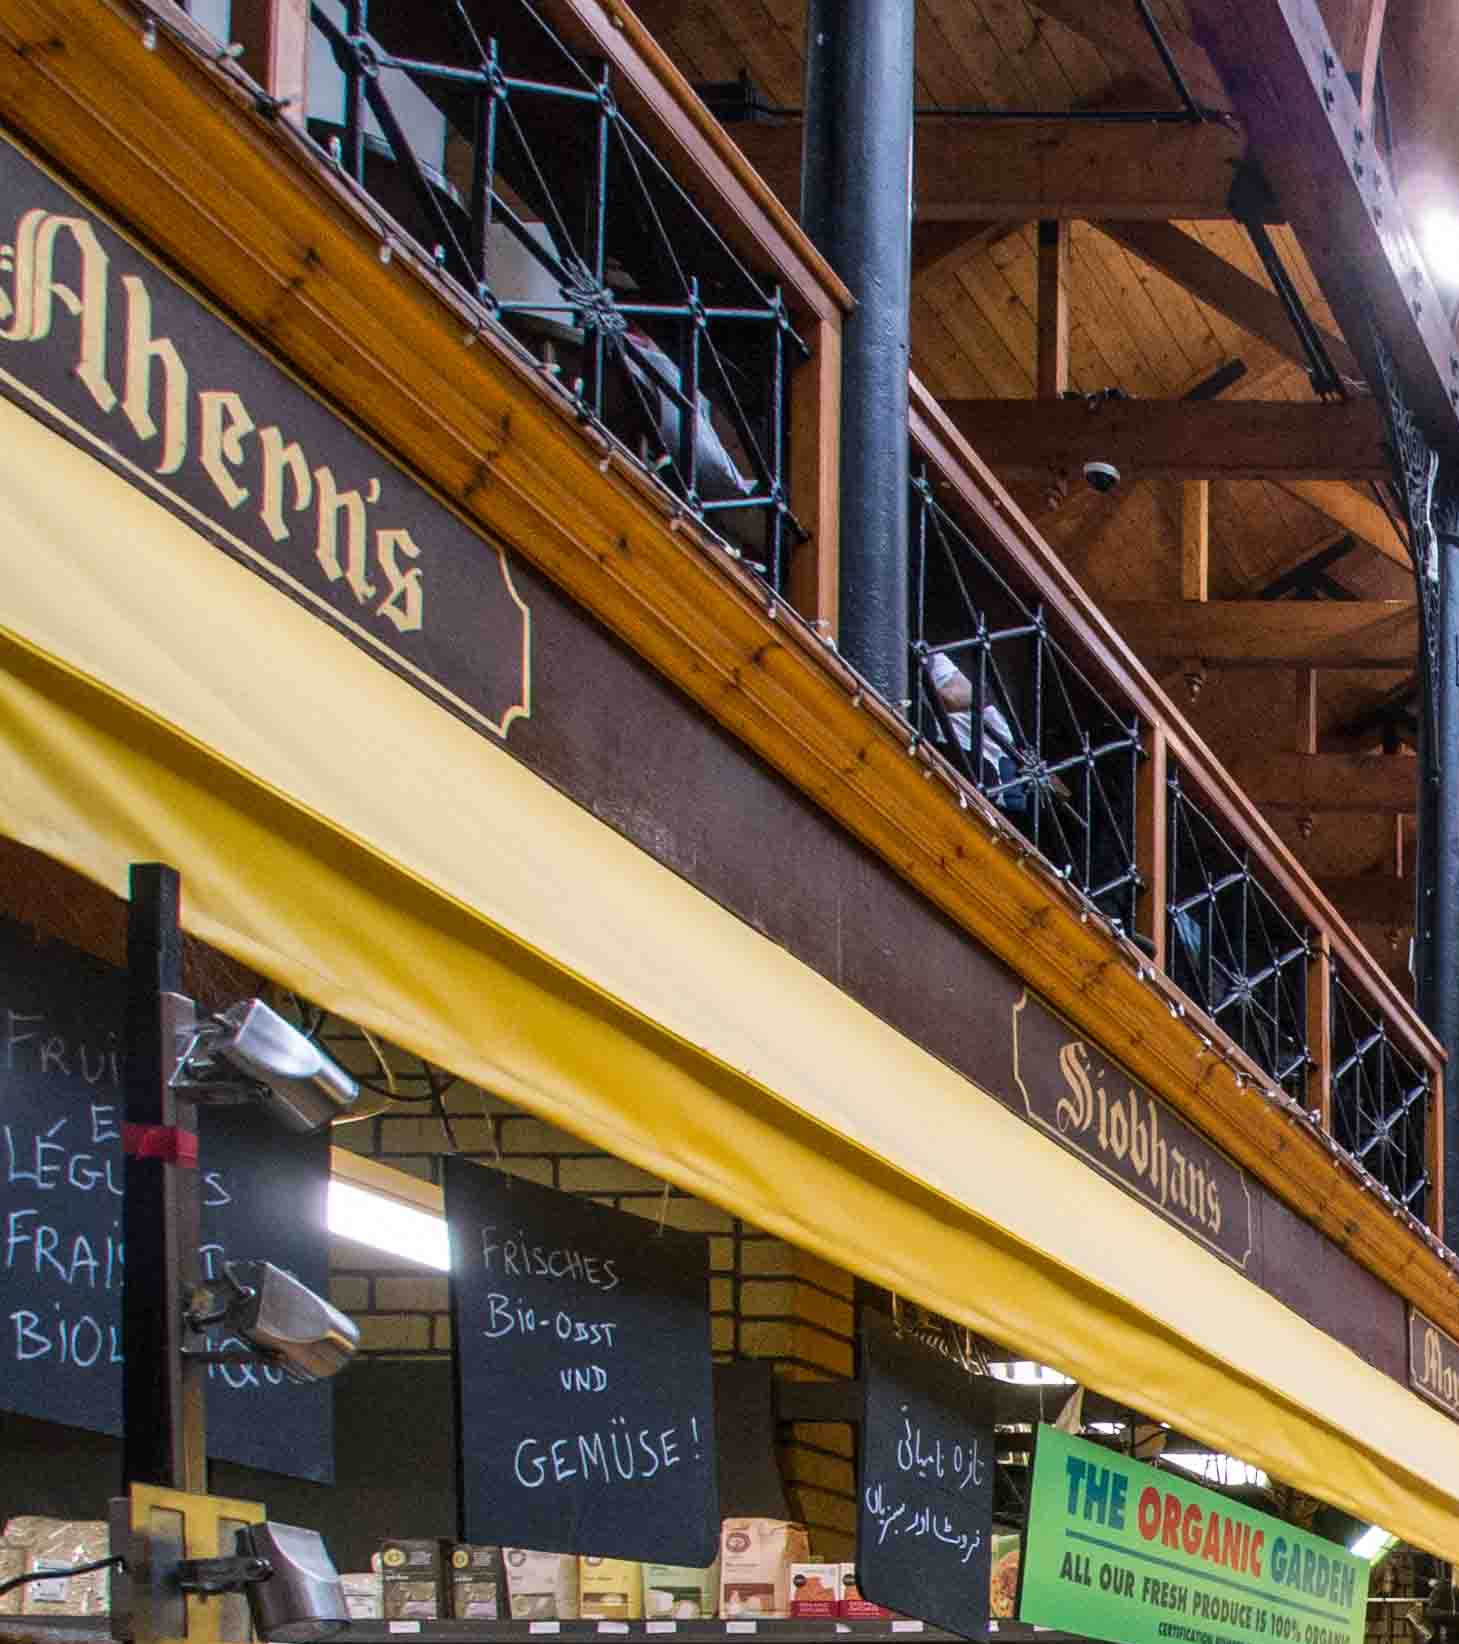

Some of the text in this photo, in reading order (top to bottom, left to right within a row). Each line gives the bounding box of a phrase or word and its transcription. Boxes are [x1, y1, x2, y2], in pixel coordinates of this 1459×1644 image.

[0, 208, 424, 632] Ahern's
[560, 1365, 608, 1392] UND
[1065, 1455, 1356, 1609] THE ORGANIC GARDEN
[1059, 1551, 1092, 1588] ALL
[1099, 1563, 1136, 1598] OUR
[1142, 1575, 1189, 1617] FRESH
[1191, 1591, 1252, 1630] PRODUCE
[1255, 1609, 1267, 1633] IS
